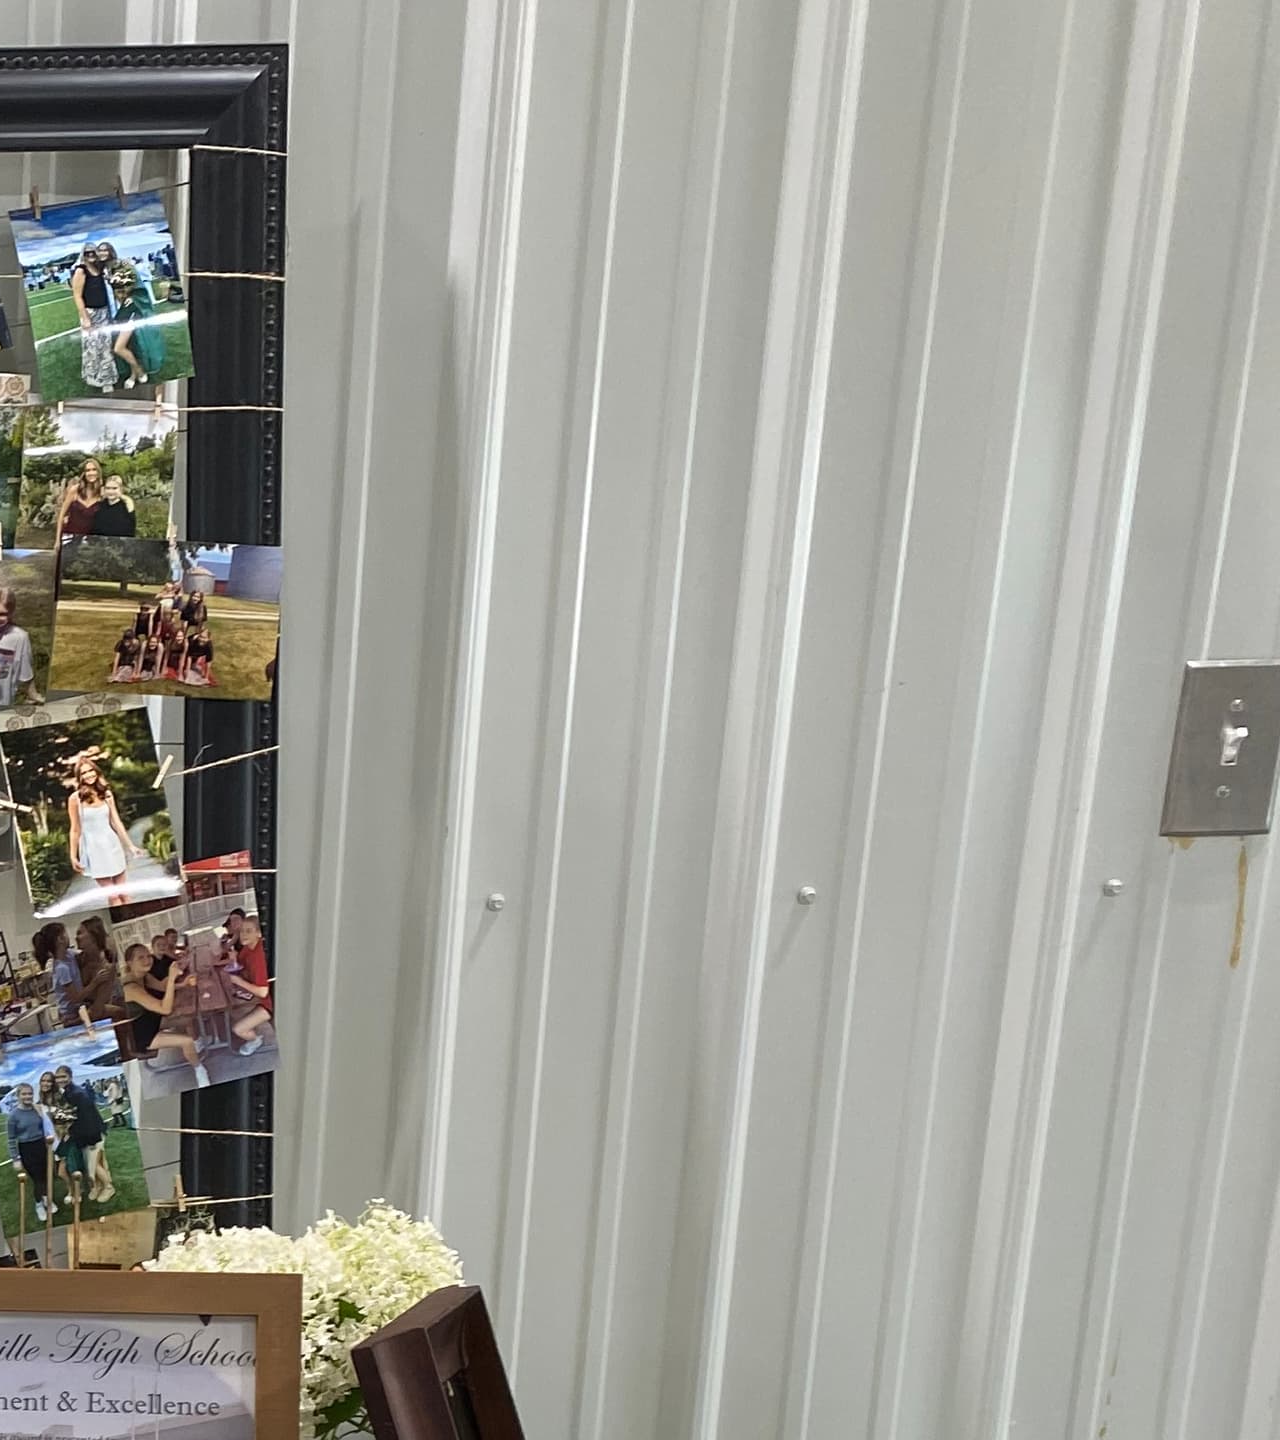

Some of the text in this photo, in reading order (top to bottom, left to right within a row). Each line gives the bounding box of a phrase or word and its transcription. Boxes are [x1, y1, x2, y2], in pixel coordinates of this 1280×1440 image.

[49, 1323, 140, 1380] High
[154, 1328, 256, 1369] Schoo
[56, 1391, 78, 1413] &
[85, 1391, 221, 1418] Excellence
